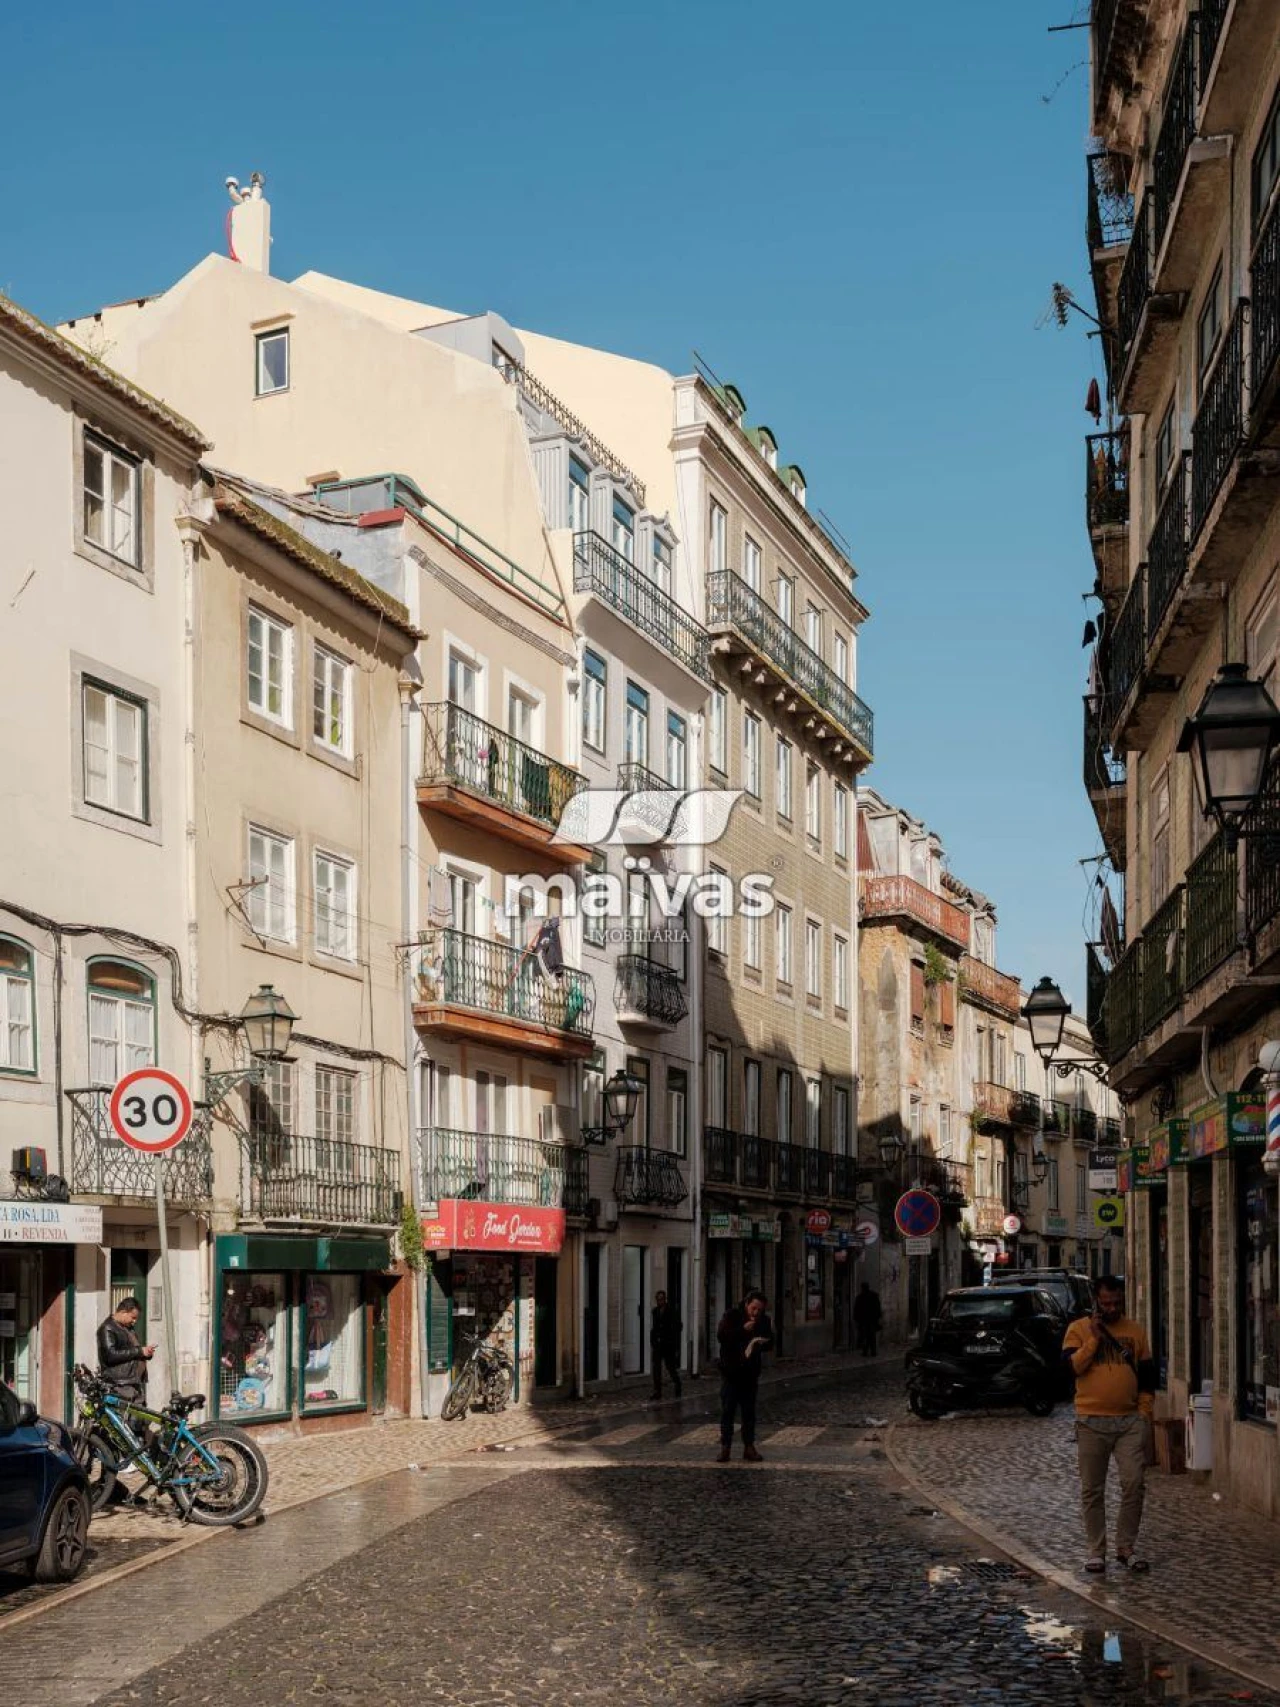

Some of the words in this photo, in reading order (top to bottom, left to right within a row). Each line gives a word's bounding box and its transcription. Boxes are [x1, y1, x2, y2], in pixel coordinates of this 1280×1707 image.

[123, 1094, 178, 1128] 30
[41, 1208, 60, 1223] LDA
[808, 1211, 827, 1225] ria
[22, 1226, 68, 1240] REVENDA
[483, 1212, 508, 1240] Food
